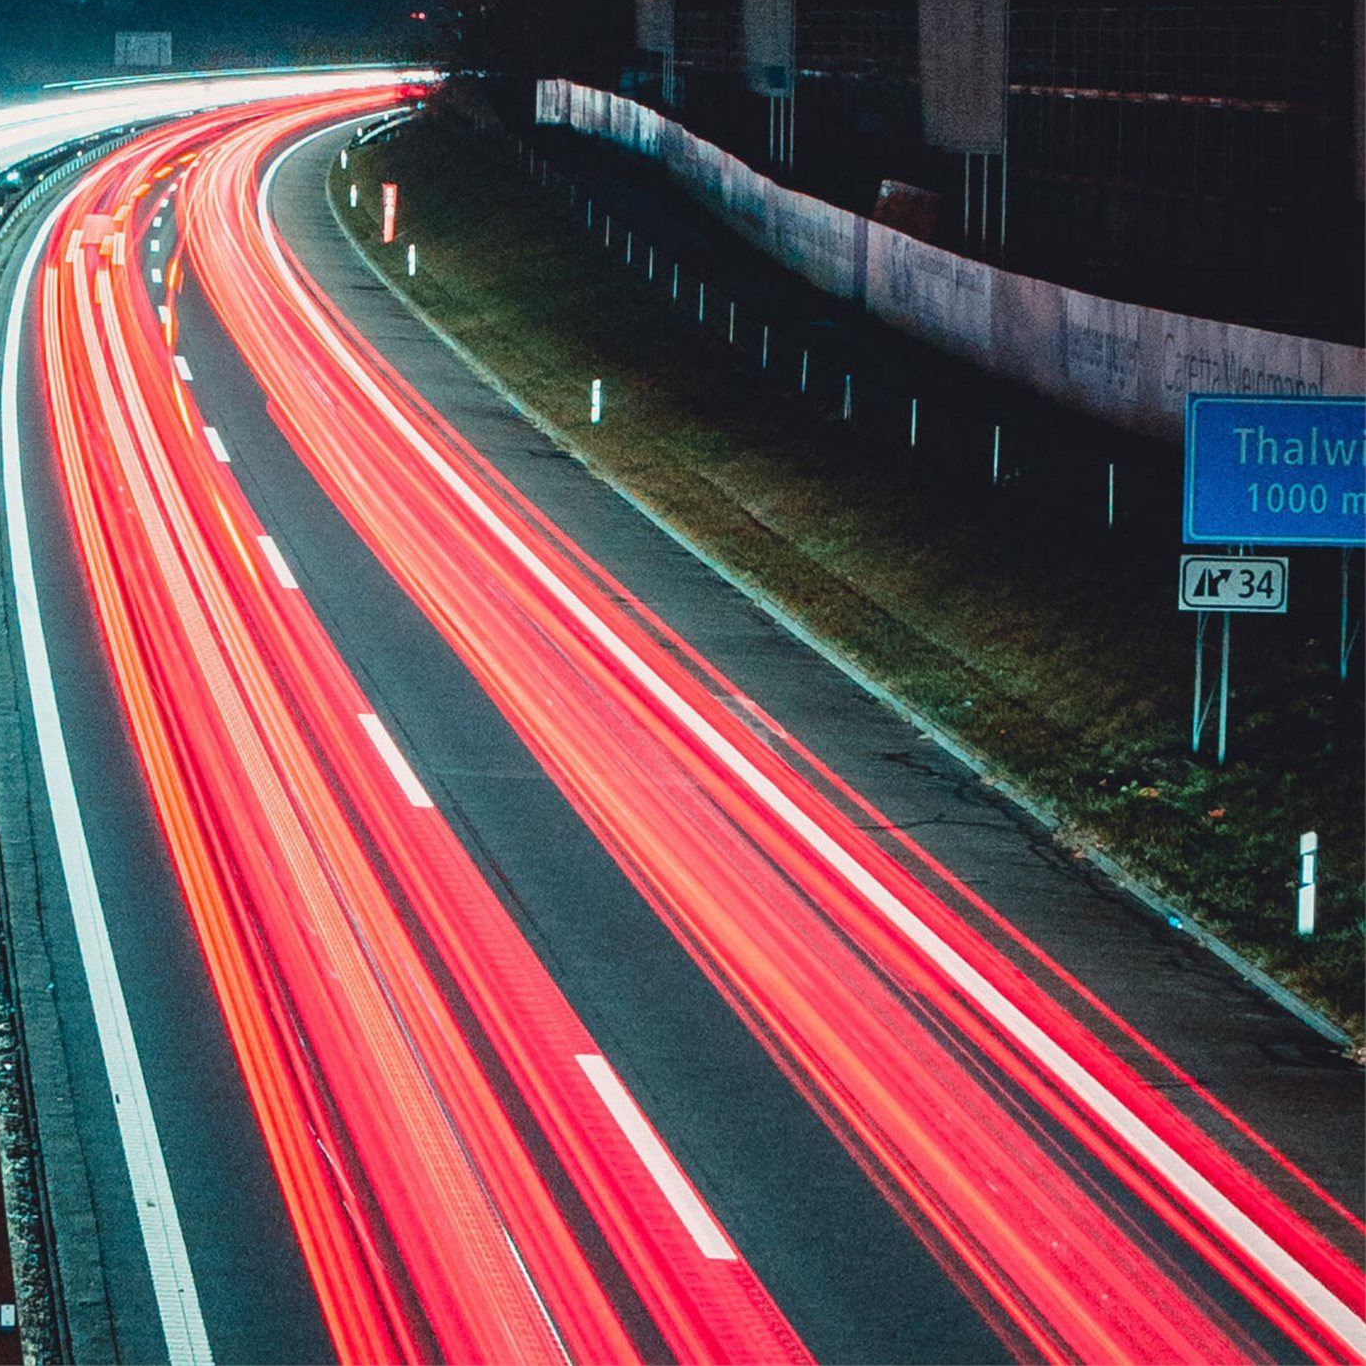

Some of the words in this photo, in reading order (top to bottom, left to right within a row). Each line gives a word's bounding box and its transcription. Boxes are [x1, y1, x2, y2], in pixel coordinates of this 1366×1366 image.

[1248, 483, 1327, 513] 1000
[1342, 492, 1366, 514] m
[1238, 569, 1274, 599] 34
